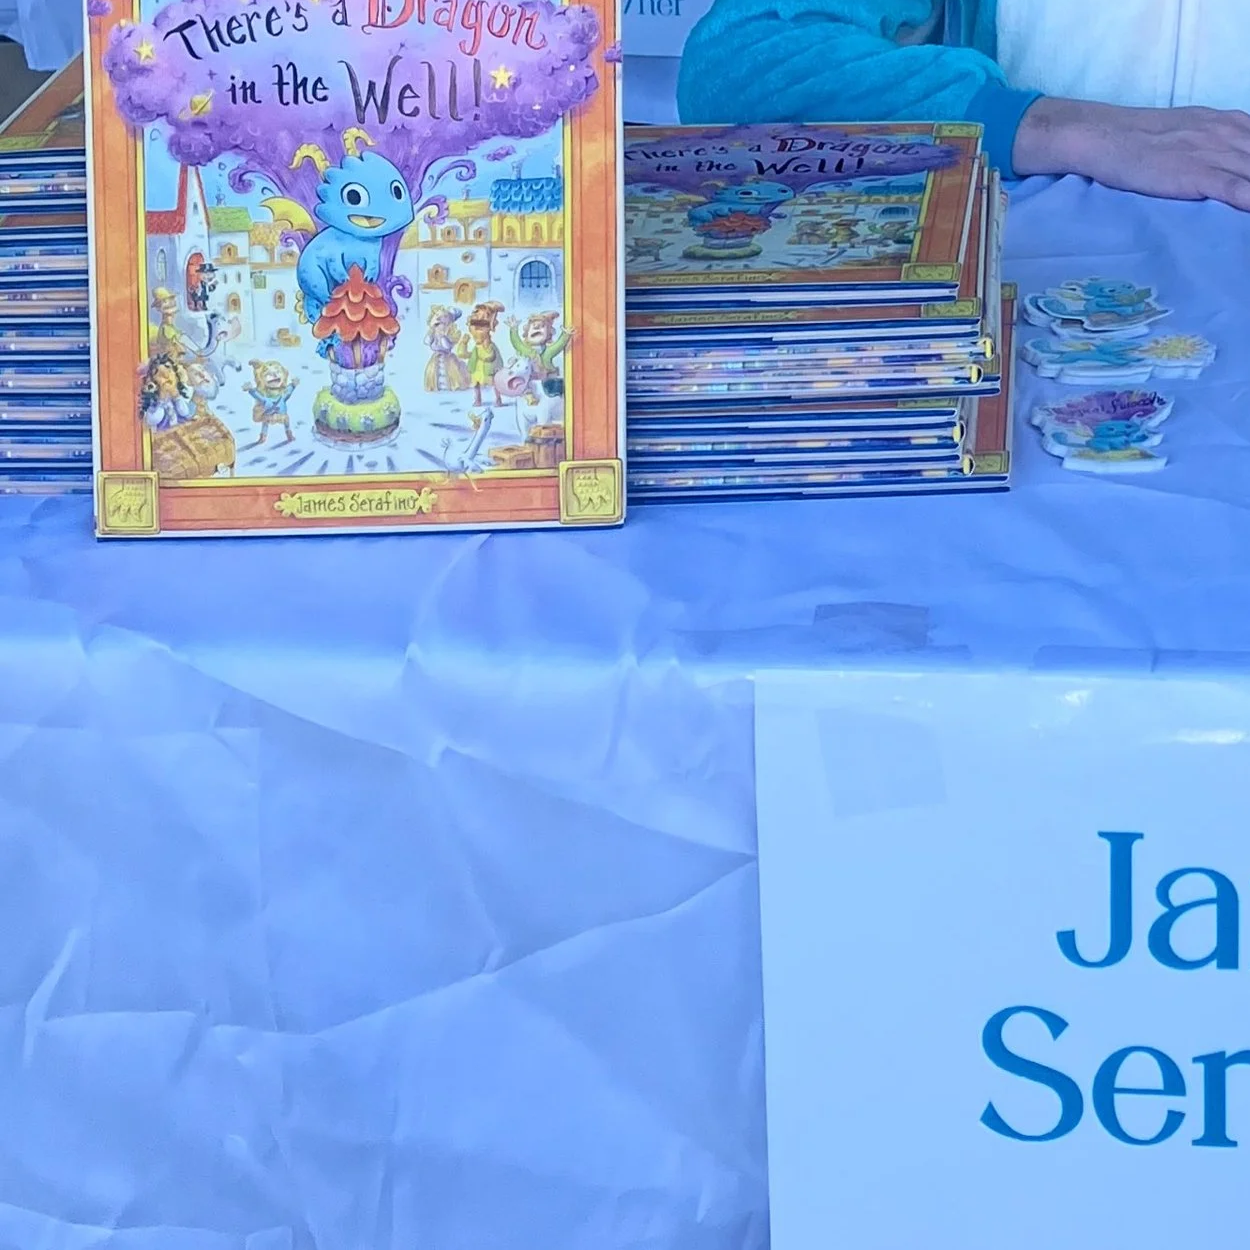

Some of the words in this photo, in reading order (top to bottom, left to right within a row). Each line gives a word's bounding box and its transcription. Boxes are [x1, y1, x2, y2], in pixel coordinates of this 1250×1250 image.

[163, 1, 309, 61] There's
[226, 74, 263, 106] in
[271, 63, 330, 107] the
[337, 55, 483, 126] Well!
[774, 136, 920, 157] Dragon
[296, 495, 346, 514] James
[350, 490, 419, 513] Serafino
